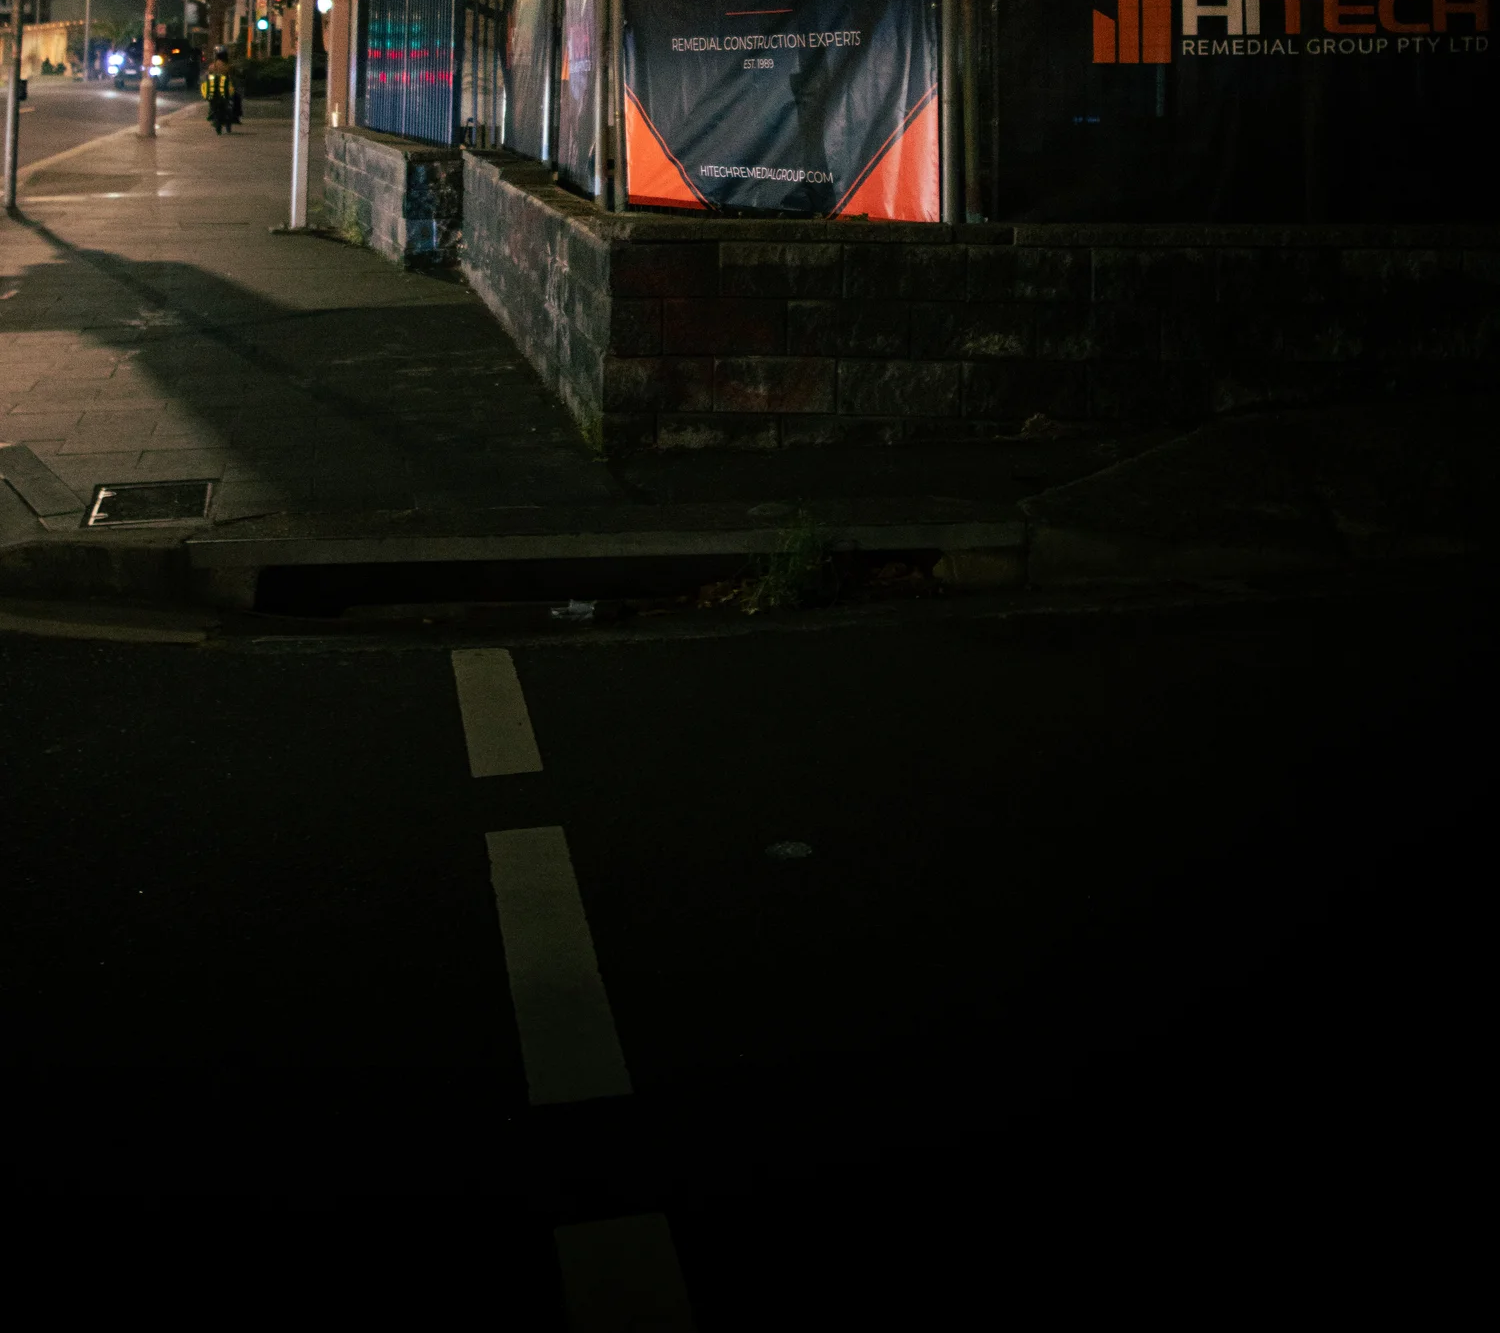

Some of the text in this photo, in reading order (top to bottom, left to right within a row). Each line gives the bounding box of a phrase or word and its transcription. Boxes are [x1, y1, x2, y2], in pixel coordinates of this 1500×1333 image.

[672, 31, 861, 52] REMEDIAL CONSTRUCTION EXPERTS
[1182, 35, 1489, 56] REMEDIAL GROUP PTY LTD
[699, 165, 834, 184] HITECHREMEDIALGROUP.COM
